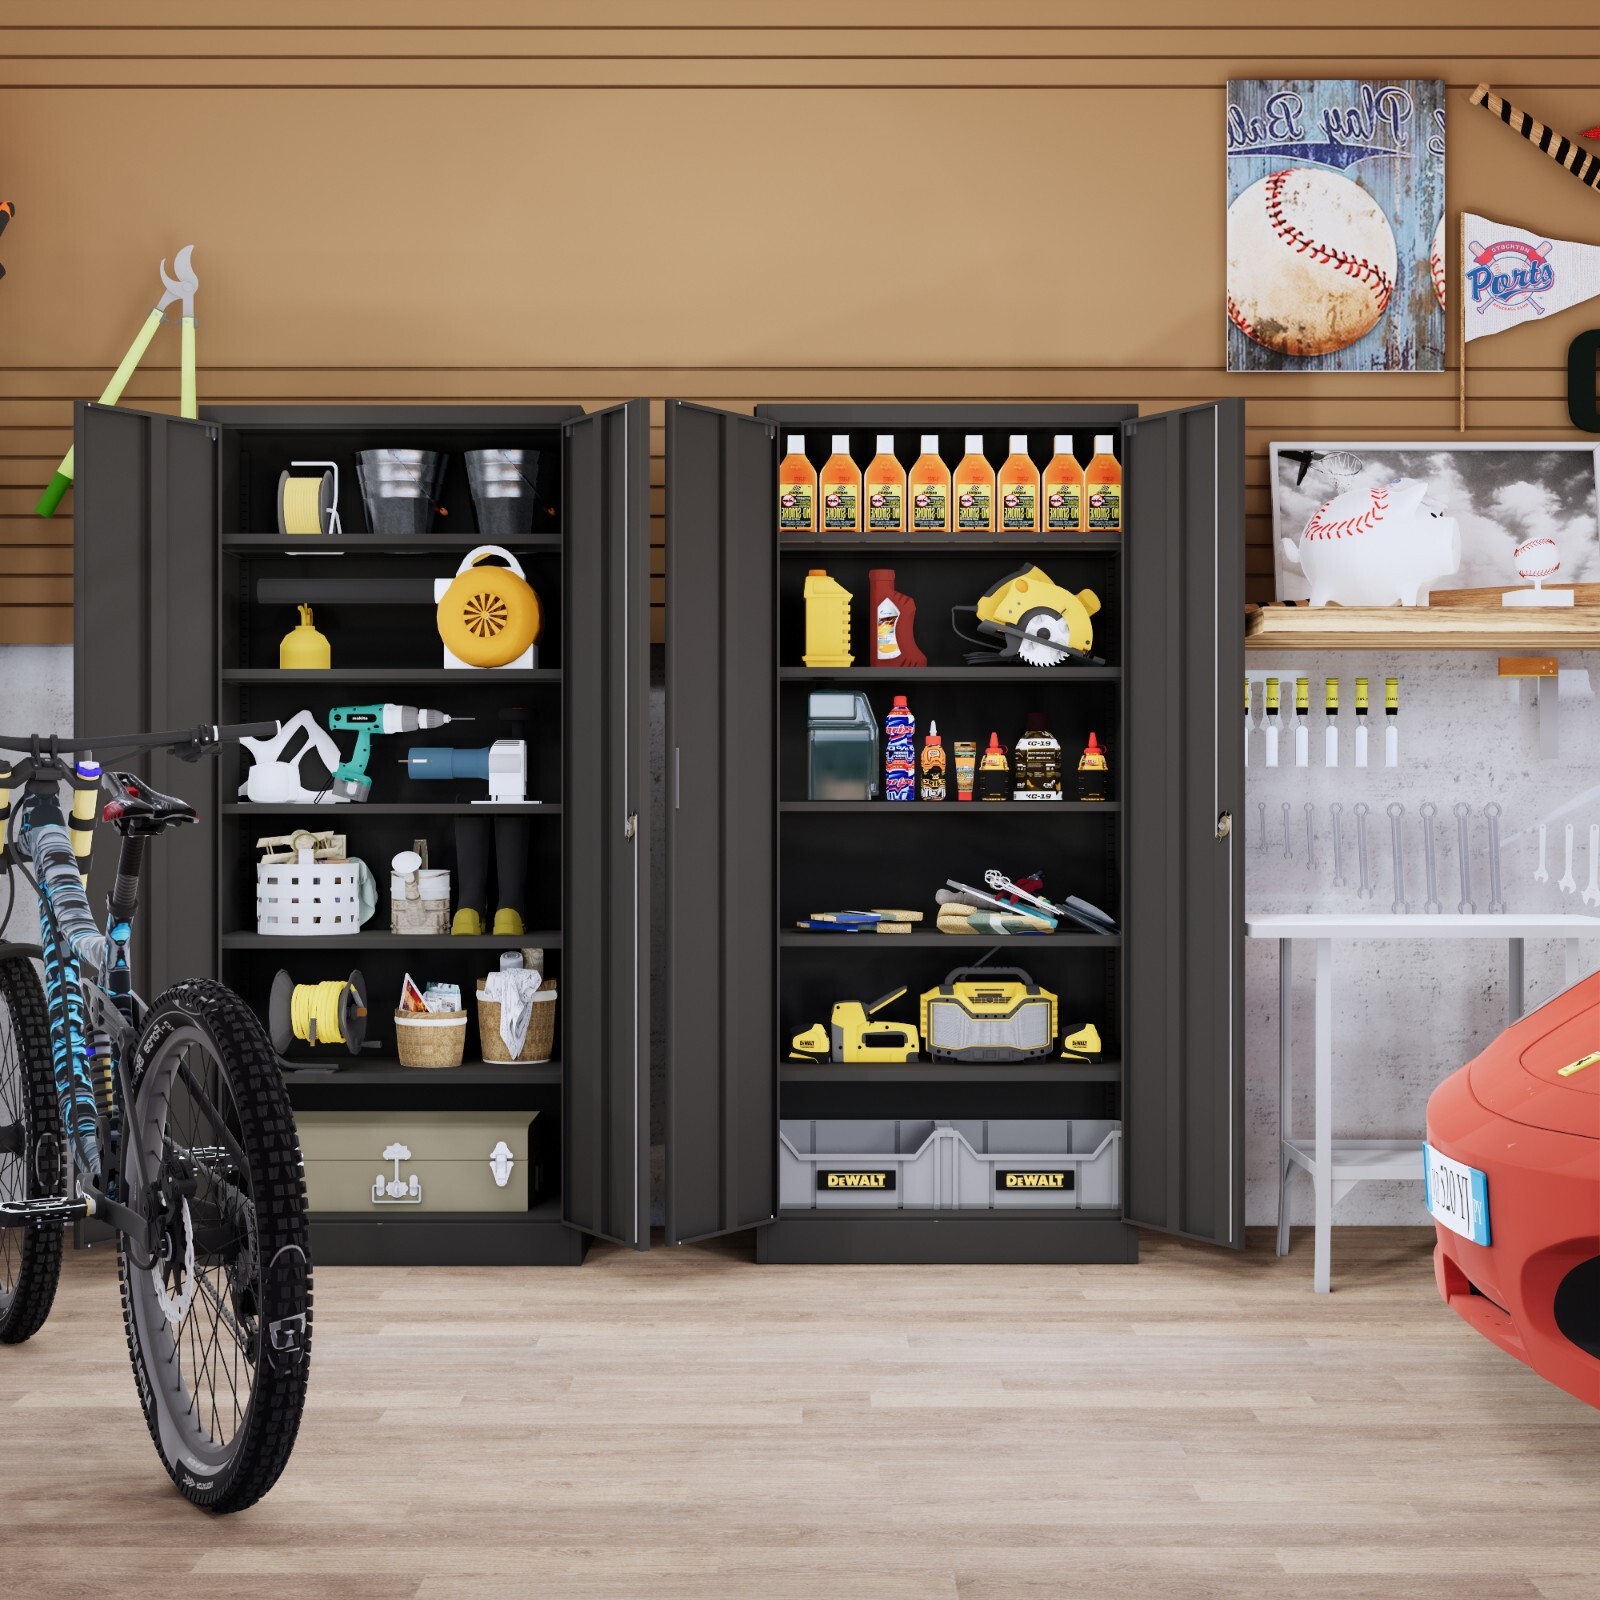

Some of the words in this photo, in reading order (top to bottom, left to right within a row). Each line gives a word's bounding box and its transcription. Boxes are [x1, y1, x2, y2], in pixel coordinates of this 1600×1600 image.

[1466, 260, 1555, 303] Ports
[827, 1173, 886, 1188] DEWALT
[1005, 1173, 1064, 1188] DEWALT
